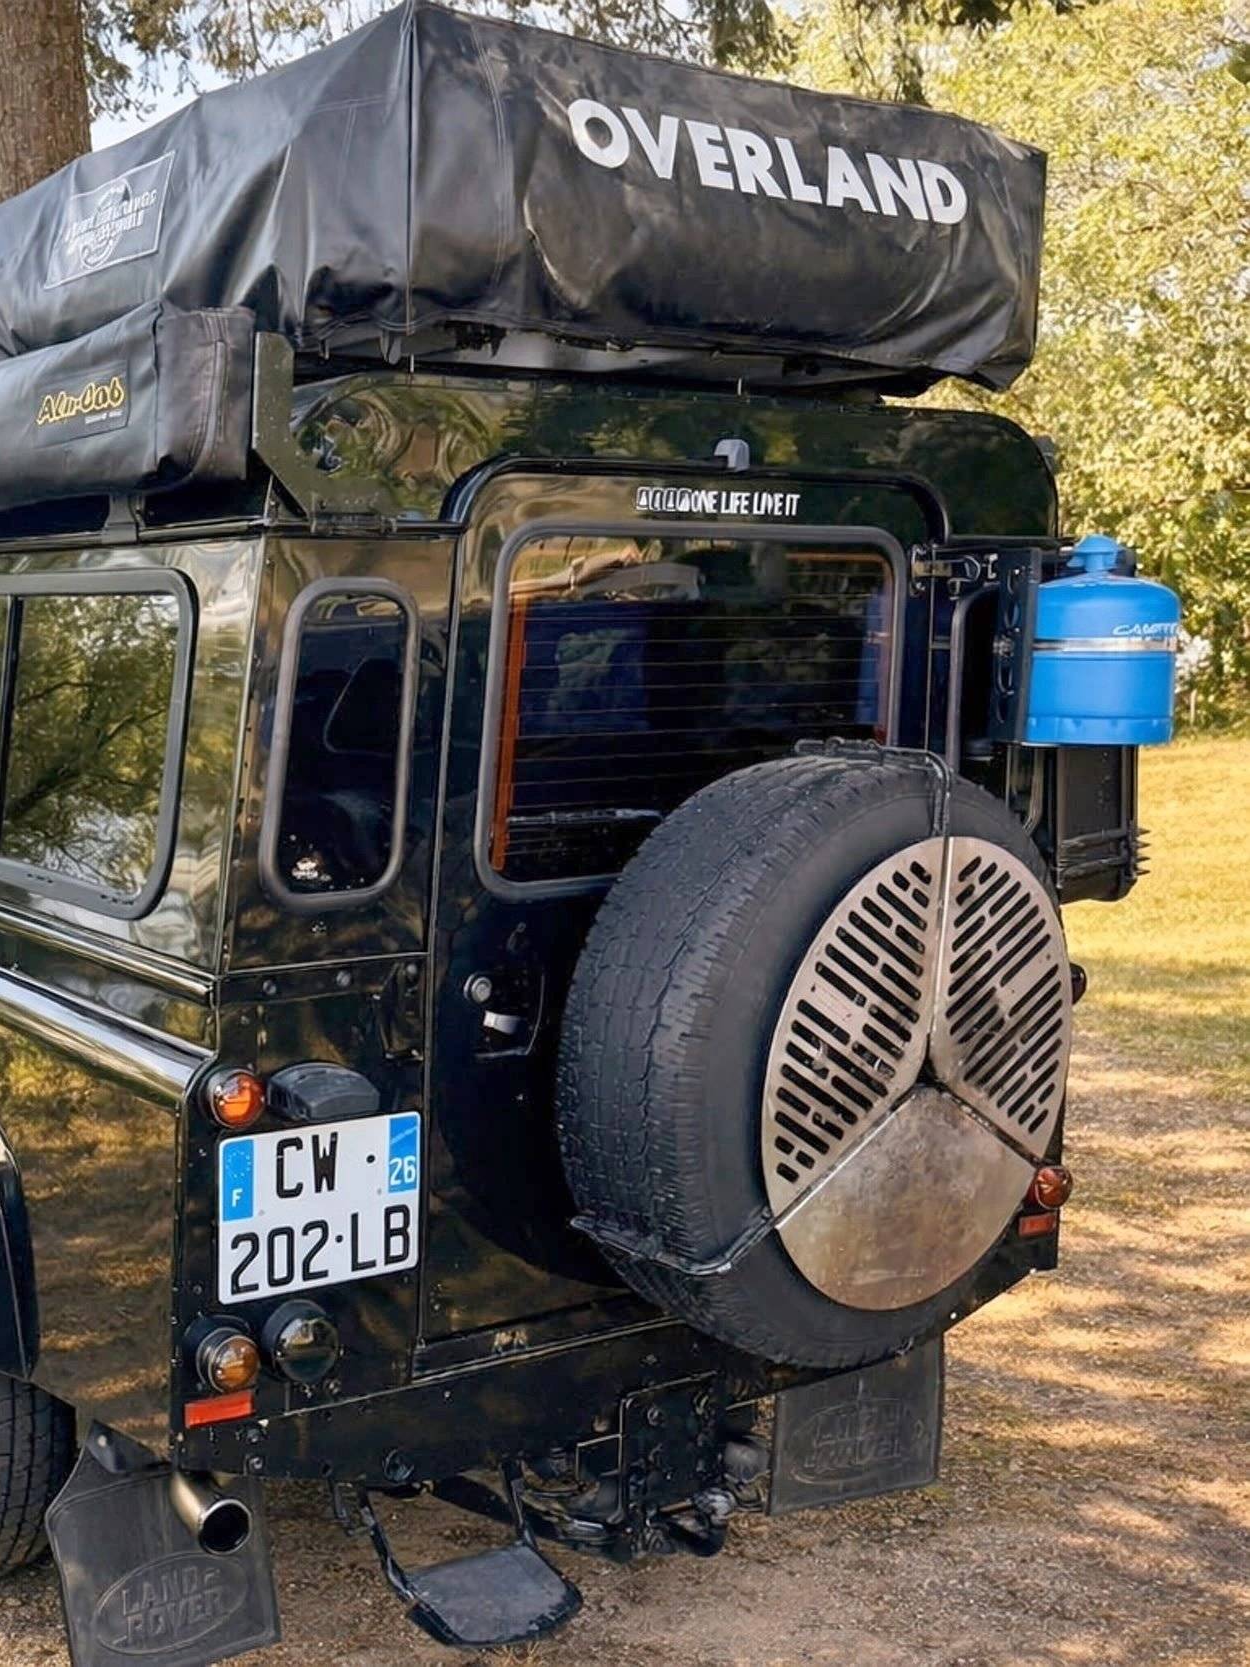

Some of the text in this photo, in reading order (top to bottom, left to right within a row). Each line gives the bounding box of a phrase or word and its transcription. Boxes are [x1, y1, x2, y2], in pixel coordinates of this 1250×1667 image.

[568, 98, 967, 225] OVERLAND
[691, 489, 801, 516] ONE LIFE LIVE IT
[389, 1155, 417, 1186] 26
[232, 1188, 244, 1208] F
